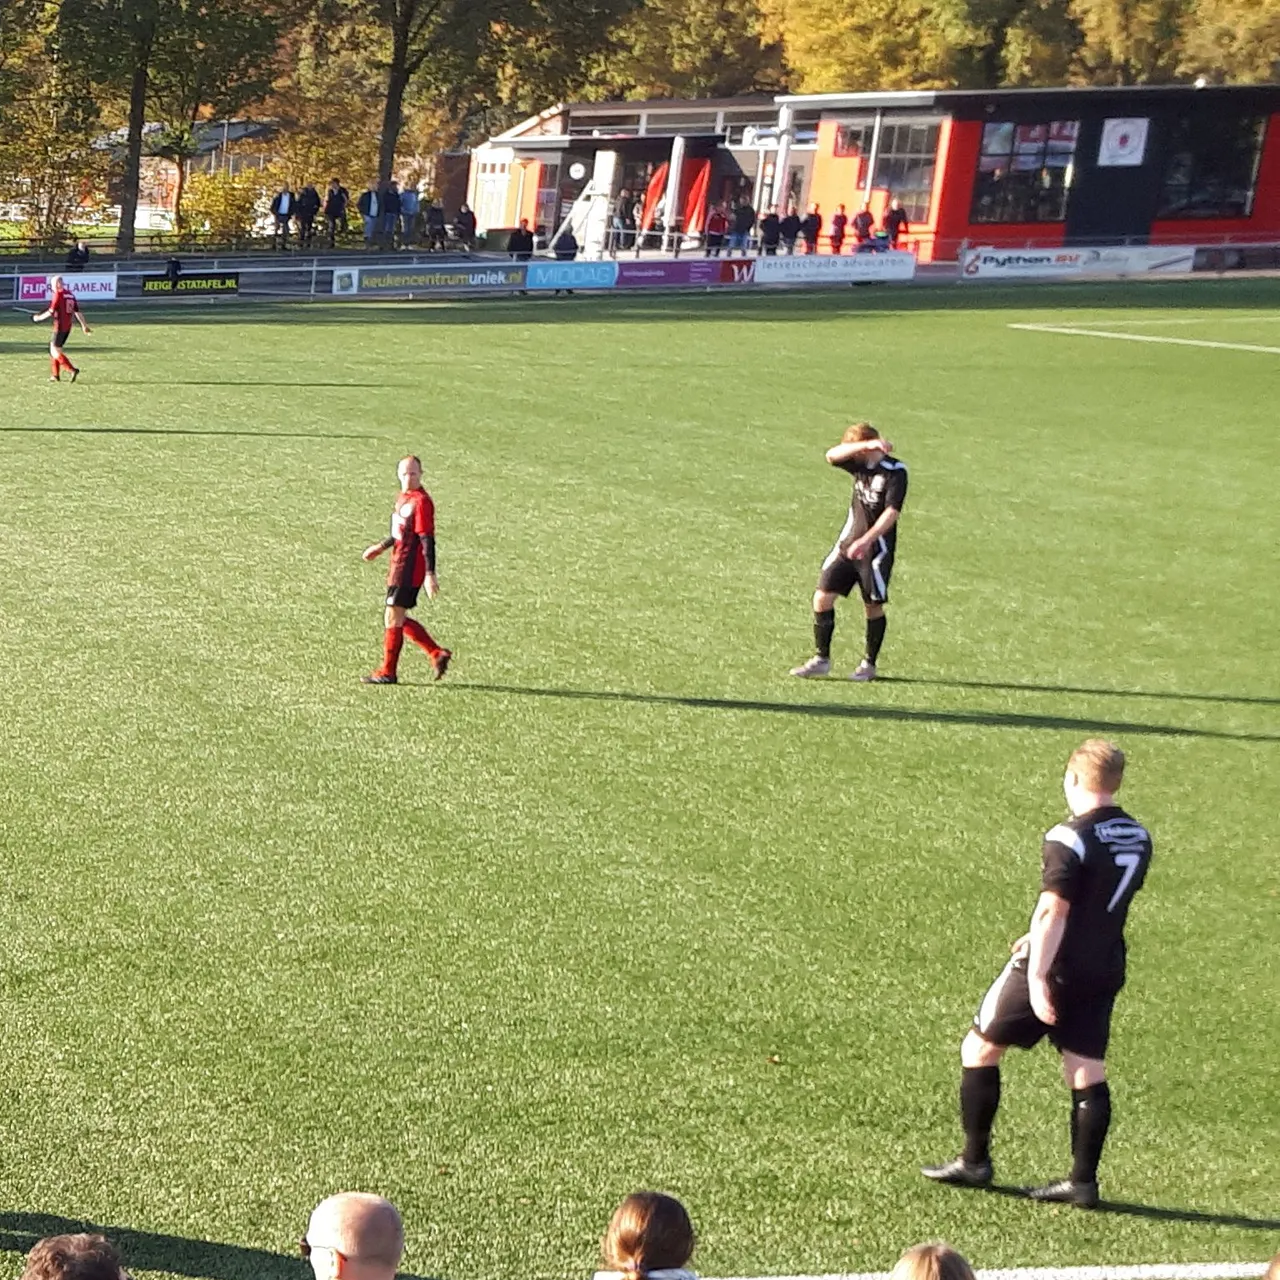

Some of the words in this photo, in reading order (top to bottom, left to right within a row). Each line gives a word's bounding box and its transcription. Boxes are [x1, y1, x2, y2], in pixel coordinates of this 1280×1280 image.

[982, 254, 1051, 268] Python
[362, 270, 522, 289] keukencentrumuniek.nl
[536, 267, 610, 285] MIDDAG
[23, 281, 114, 295] FLIPRLAME.NL
[1106, 853, 1140, 913] 7
